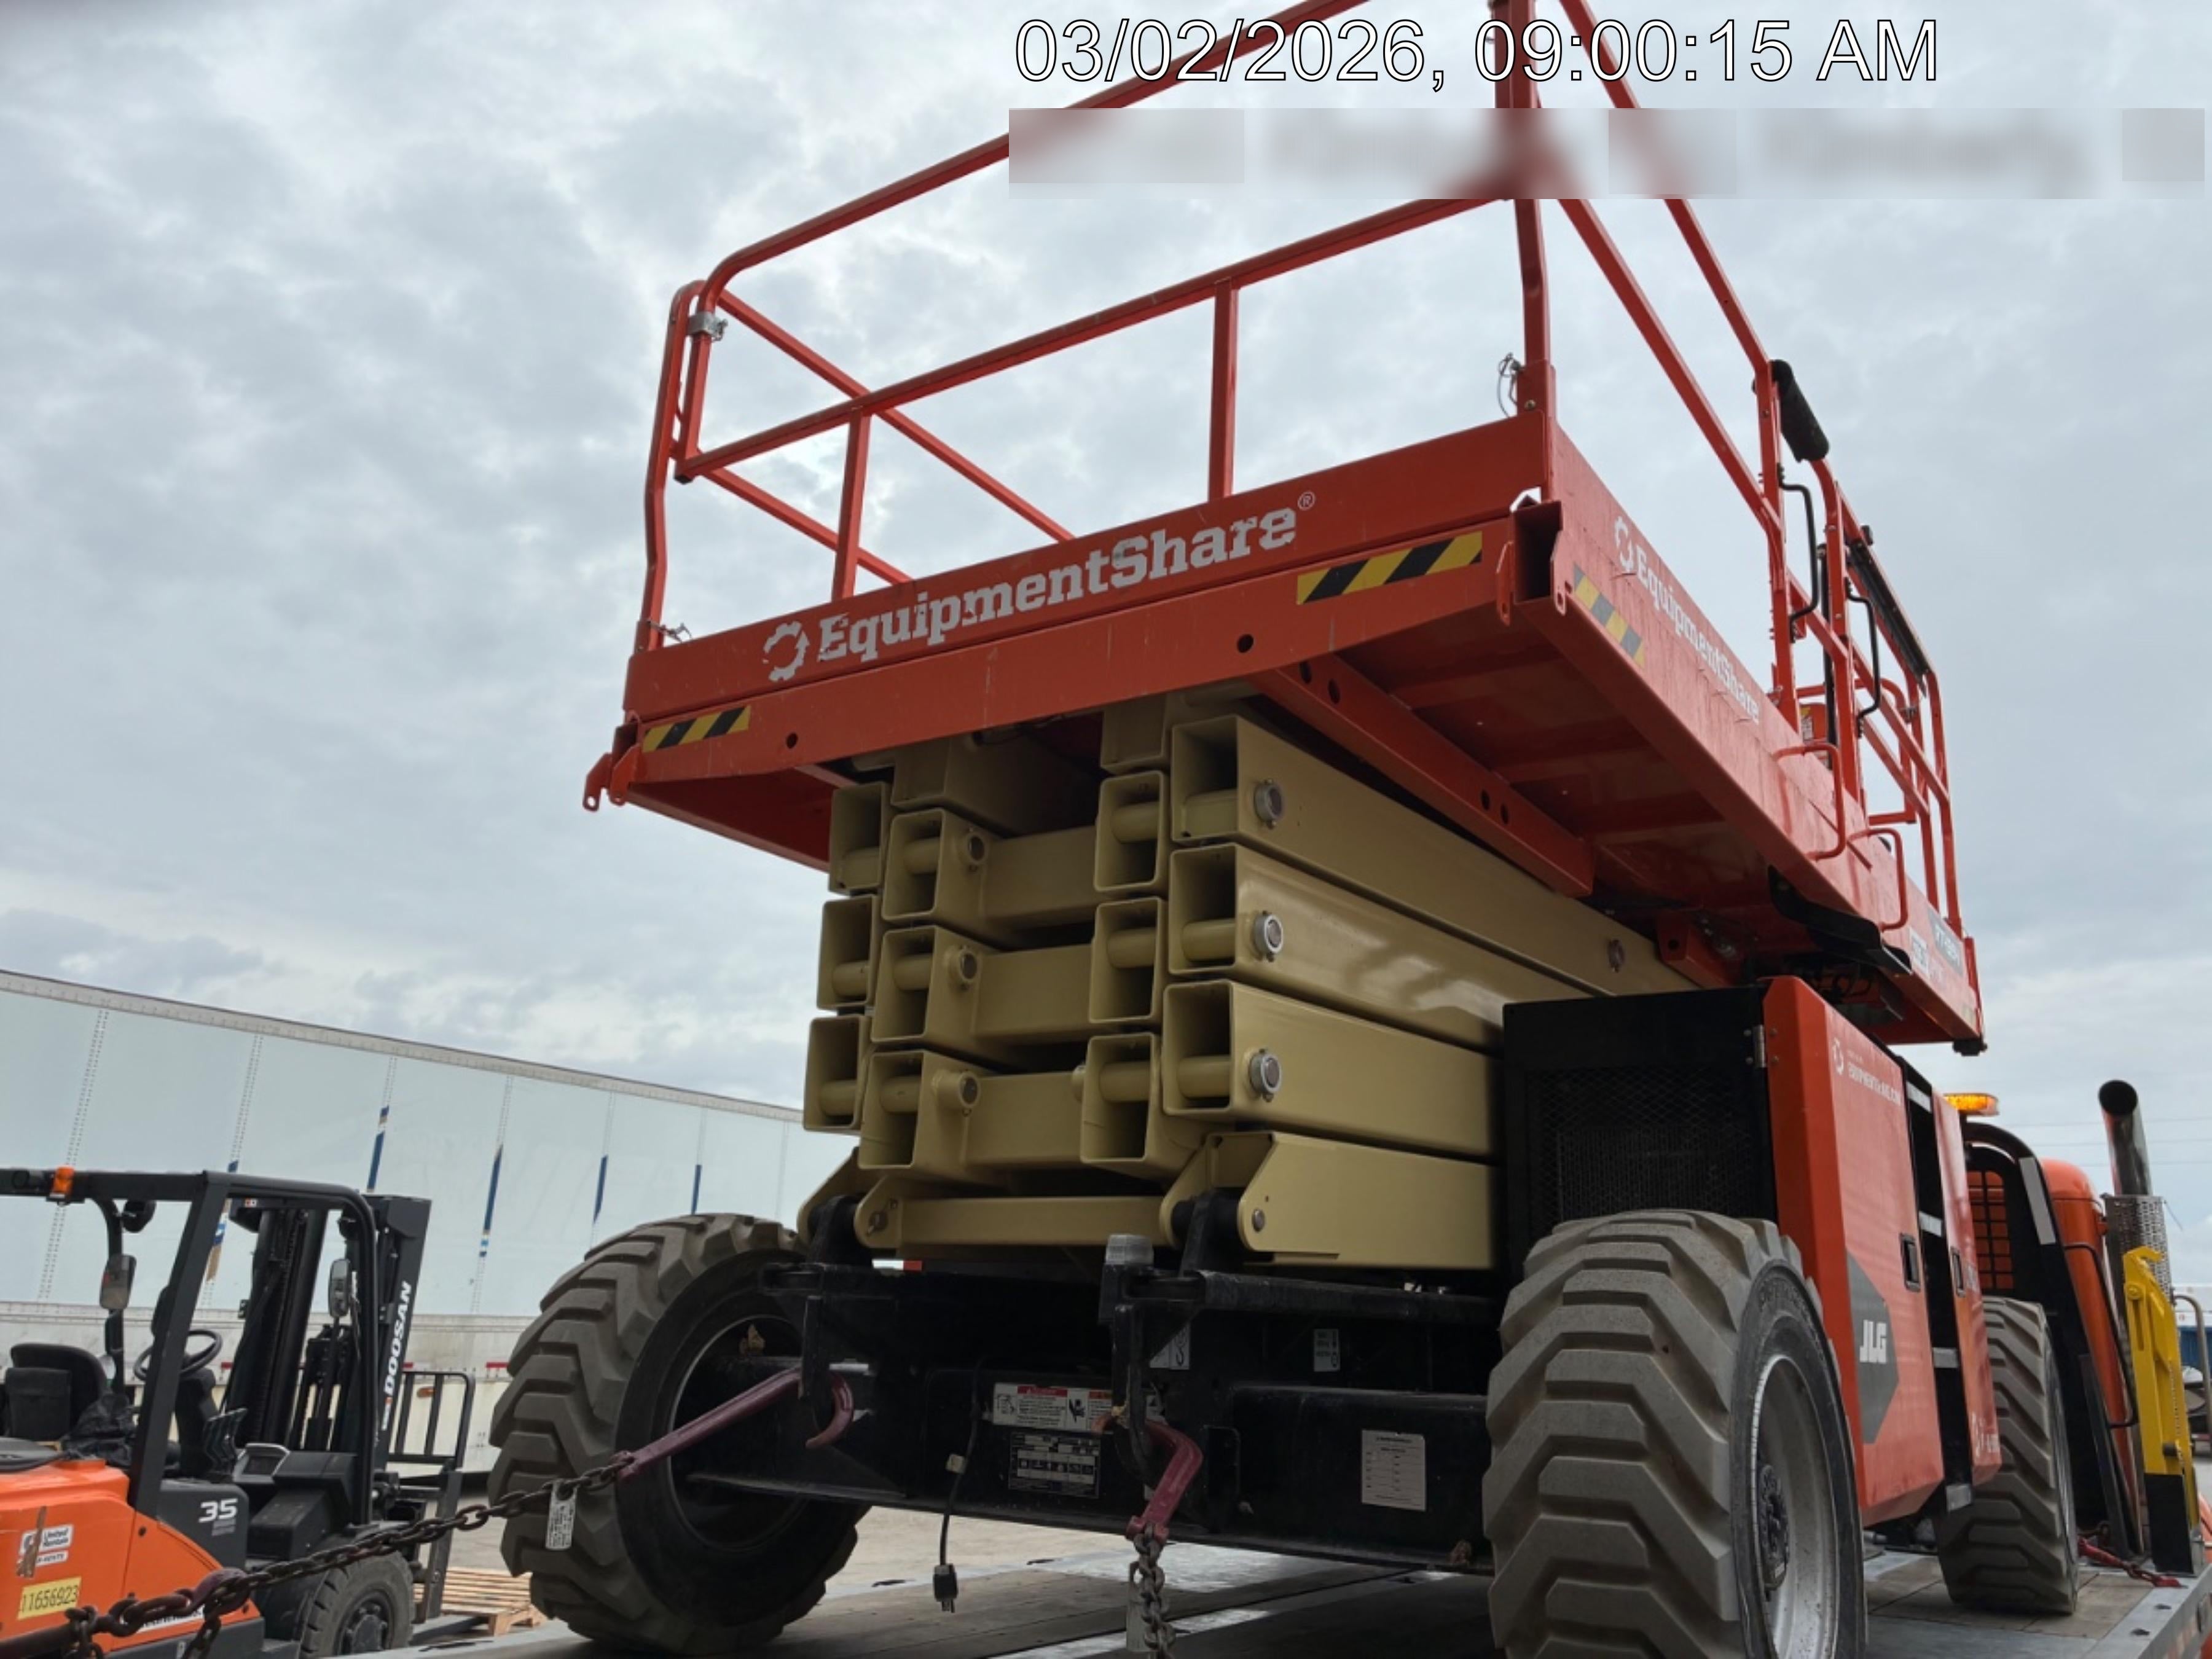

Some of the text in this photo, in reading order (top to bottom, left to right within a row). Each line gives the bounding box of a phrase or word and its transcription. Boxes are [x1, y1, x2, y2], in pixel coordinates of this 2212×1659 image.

[818, 507, 1296, 662] EquipmentShare
[383, 1281, 412, 1396] DOOSAN
[1859, 1319, 1887, 1363] JLG
[198, 1497, 238, 1523] 35
[22, 1584, 78, 1612] 11656923
